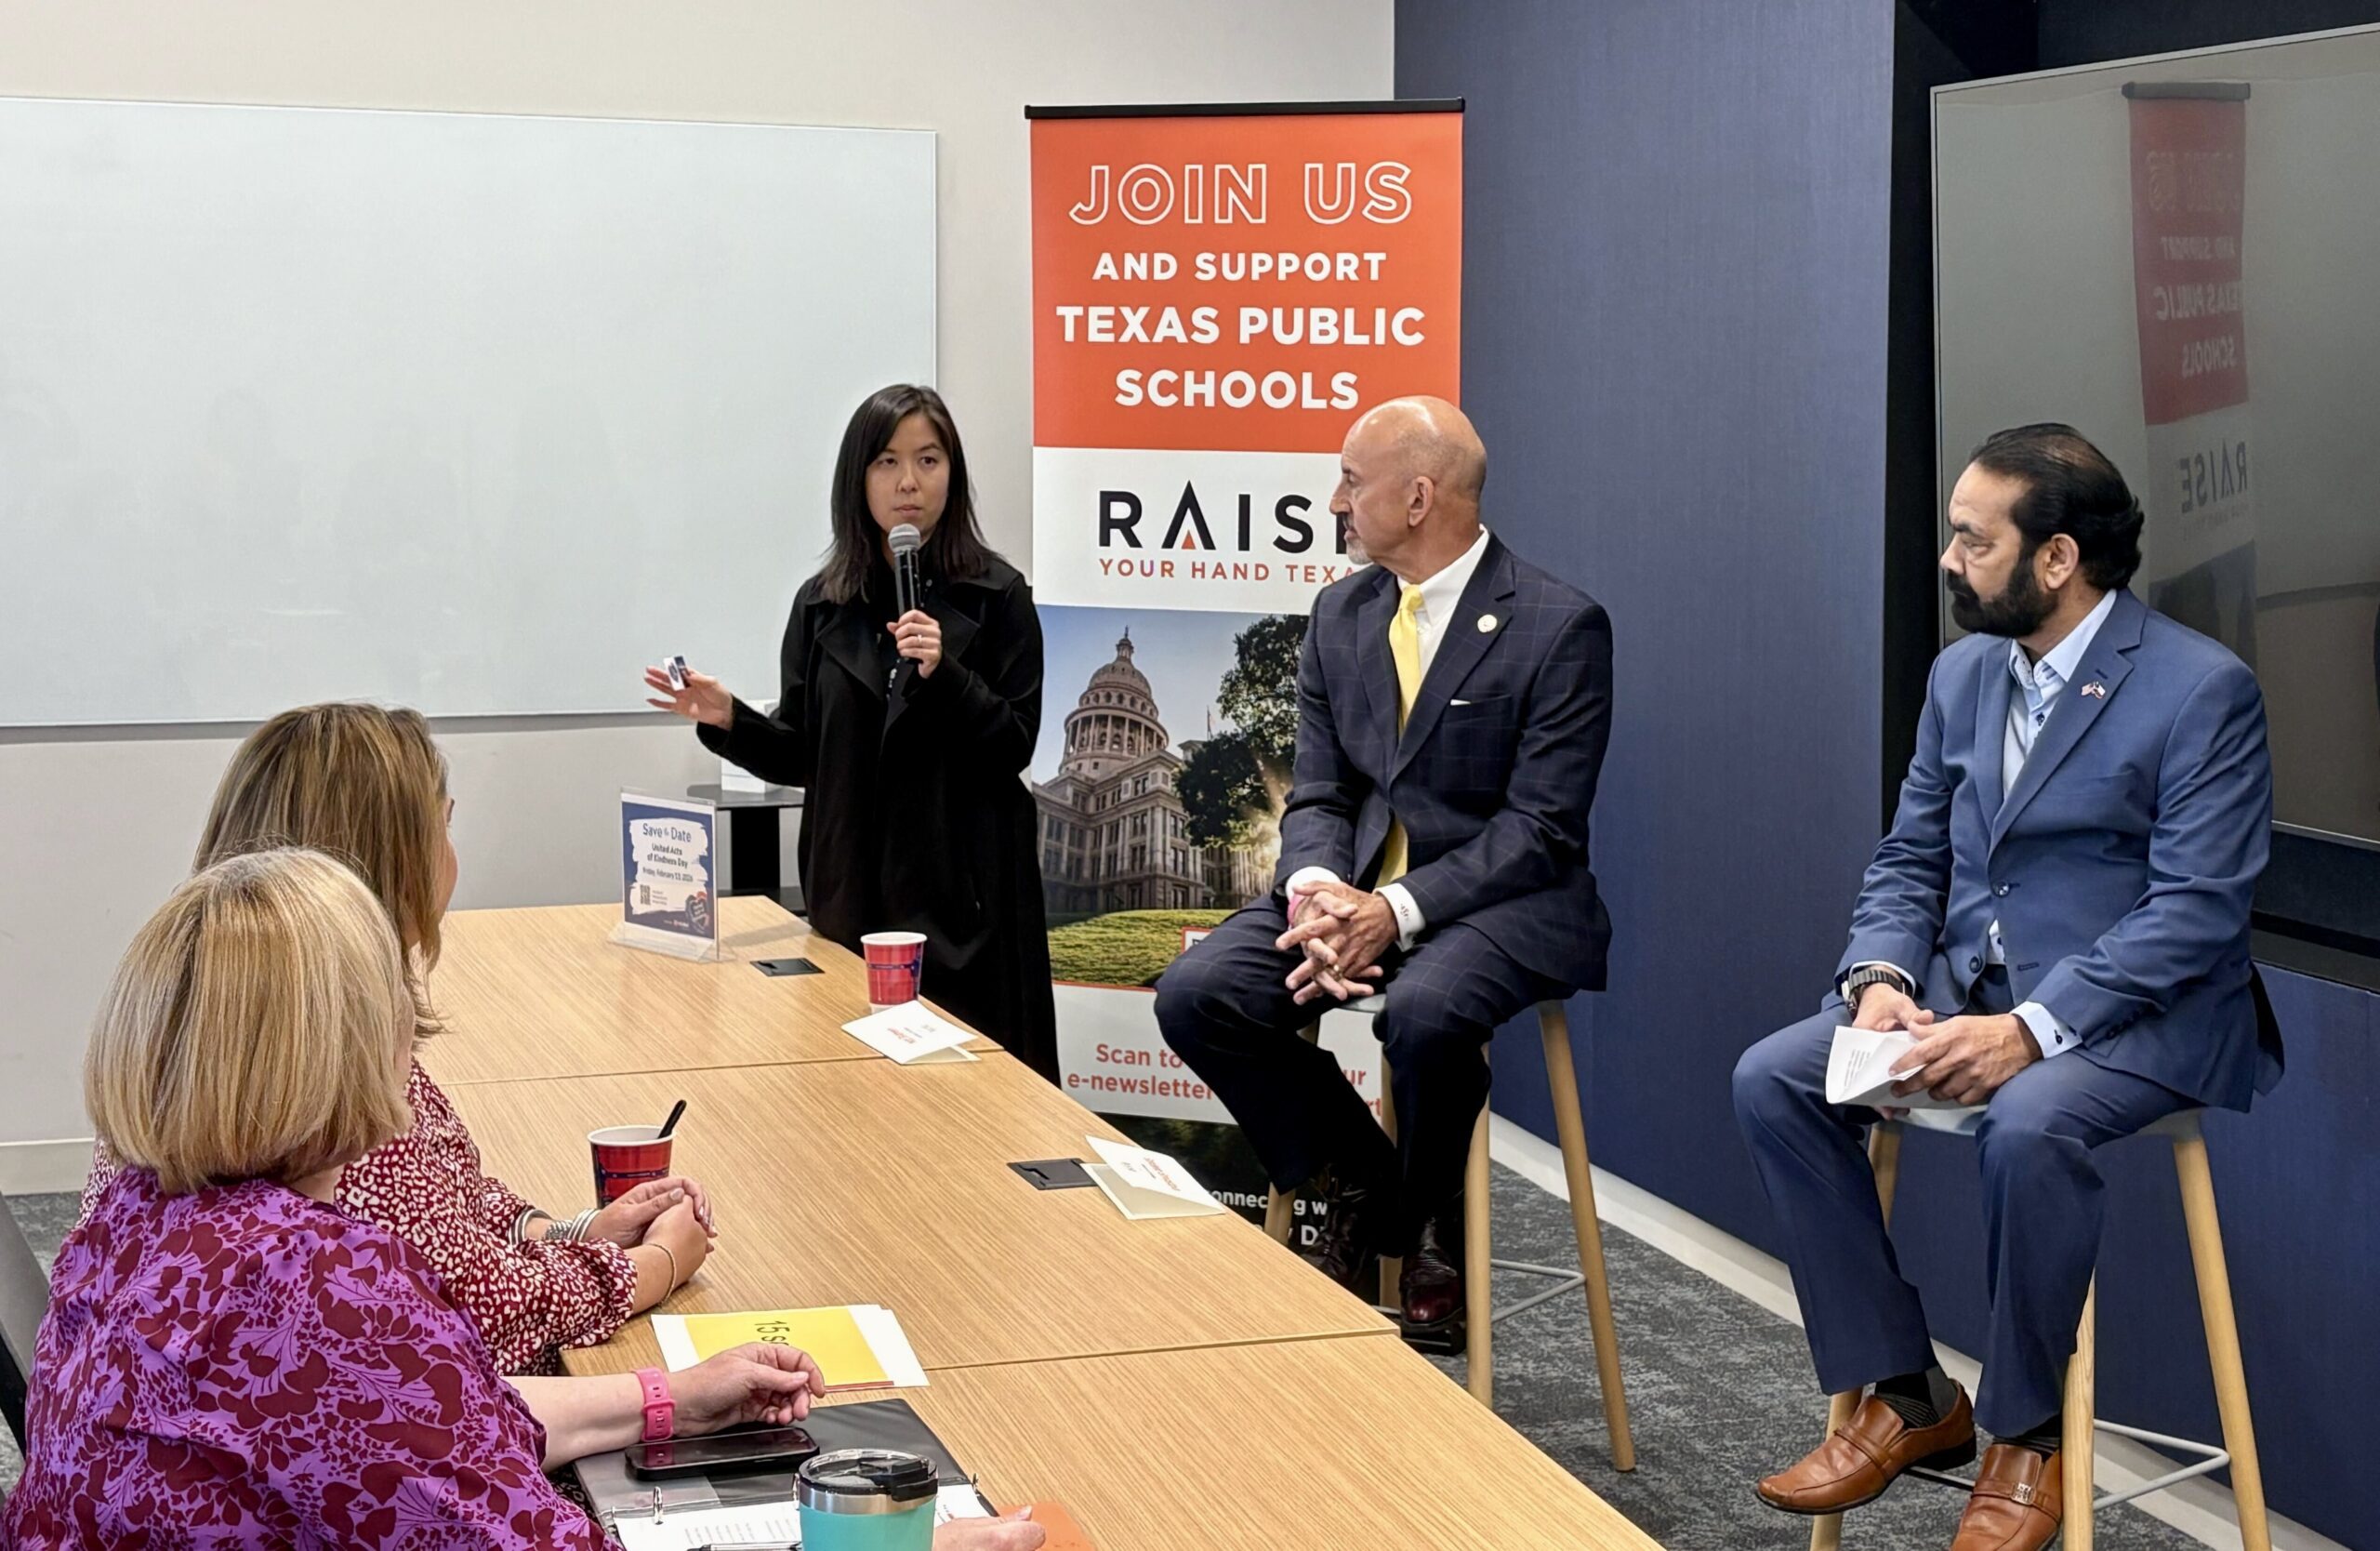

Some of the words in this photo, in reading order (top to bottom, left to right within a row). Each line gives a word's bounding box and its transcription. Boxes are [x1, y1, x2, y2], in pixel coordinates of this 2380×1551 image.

[1069, 164, 1267, 225] JOIN
[1304, 161, 1412, 224] US
[1092, 252, 1178, 281] AND
[1195, 251, 1387, 282] SUPPORT
[1056, 306, 1220, 345] TEXAS
[1238, 307, 1426, 347] PUBLIC
[1115, 368, 1359, 409] SCHOOLS
[1098, 480, 1347, 555] RAIS
[1099, 558, 1175, 578] YOUR
[1191, 561, 1270, 582] HAND
[1285, 563, 1355, 584] TEXA
[642, 822, 663, 838] Save
[670, 827, 692, 842] Date
[652, 842, 669, 854] United
[1096, 1043, 1150, 1066] Scan
[1159, 1049, 1183, 1068] to
[754, 1320, 790, 1334] 15
